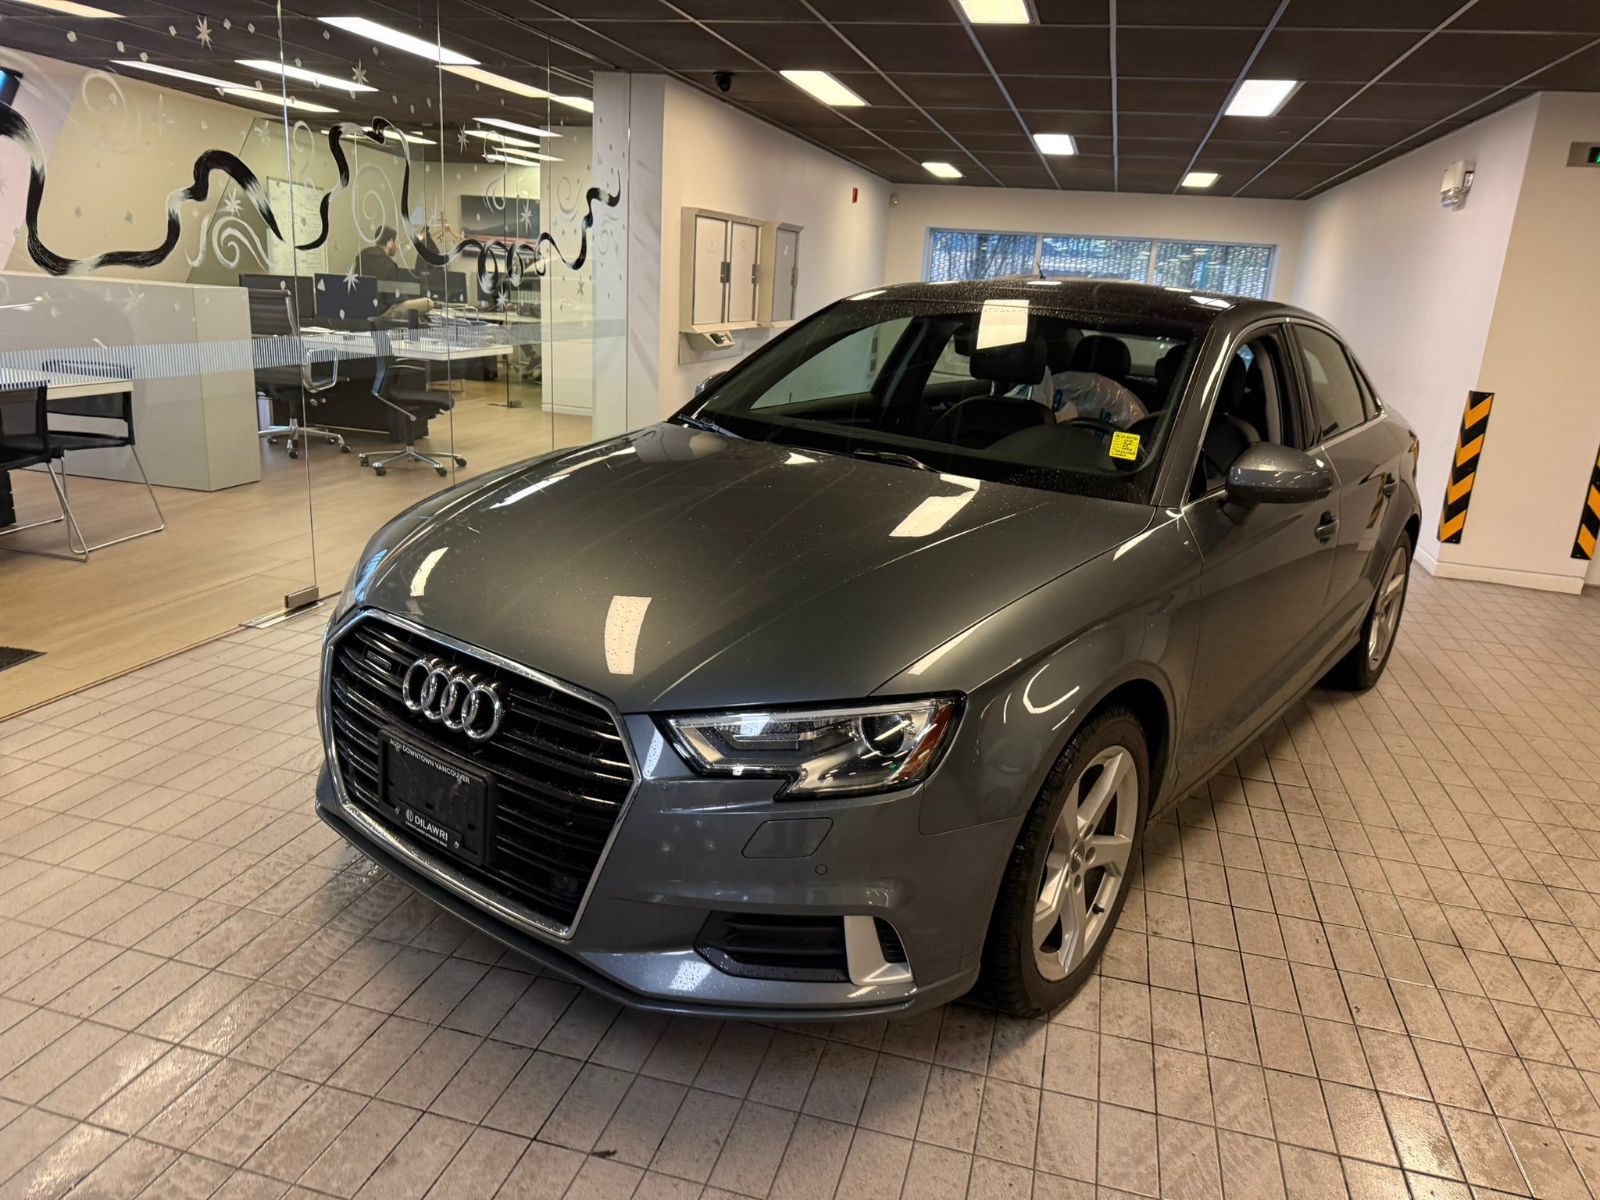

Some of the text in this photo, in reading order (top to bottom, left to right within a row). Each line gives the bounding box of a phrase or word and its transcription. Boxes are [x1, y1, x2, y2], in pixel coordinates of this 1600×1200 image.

[402, 745, 435, 766] DOWNTOWN
[435, 762, 470, 784] VANCOUVER
[414, 815, 448, 842] DILAWRI
